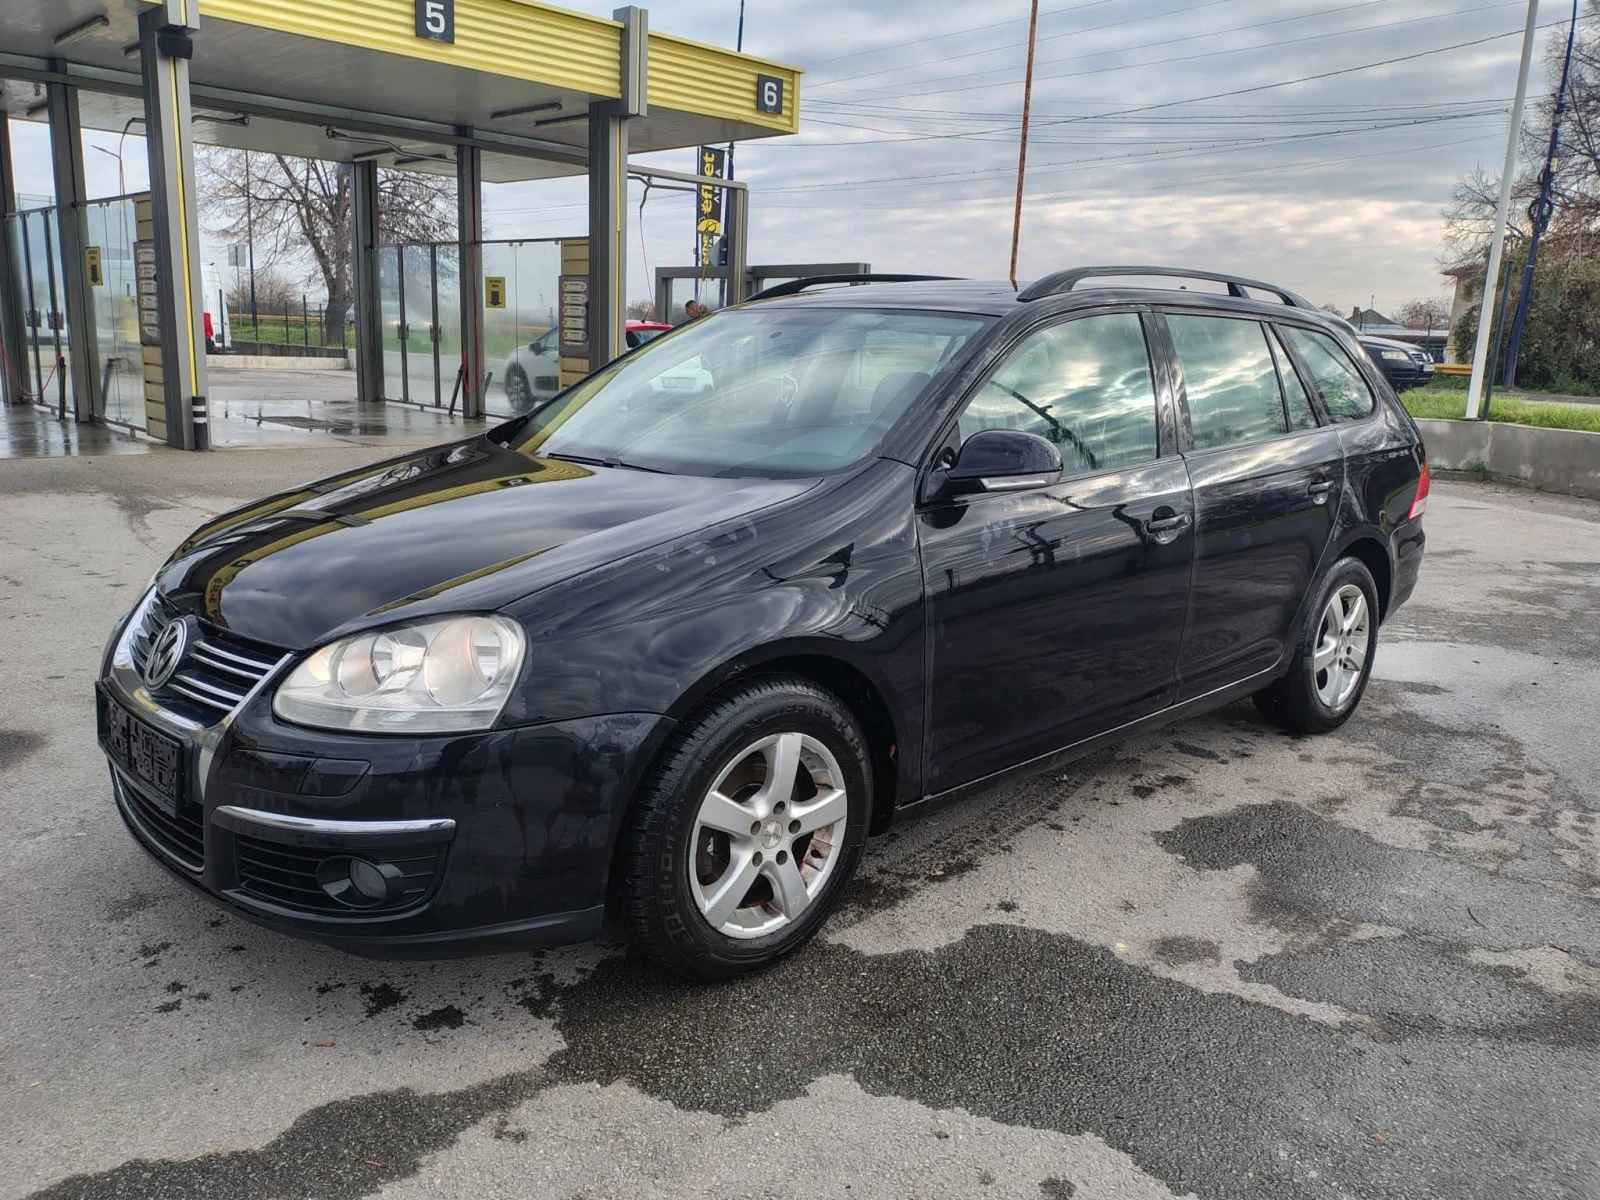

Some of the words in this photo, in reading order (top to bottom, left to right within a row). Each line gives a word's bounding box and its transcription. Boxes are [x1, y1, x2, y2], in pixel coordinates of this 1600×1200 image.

[426, 1, 445, 34] 5
[764, 81, 778, 107] 6
[146, 619, 186, 690] VW
